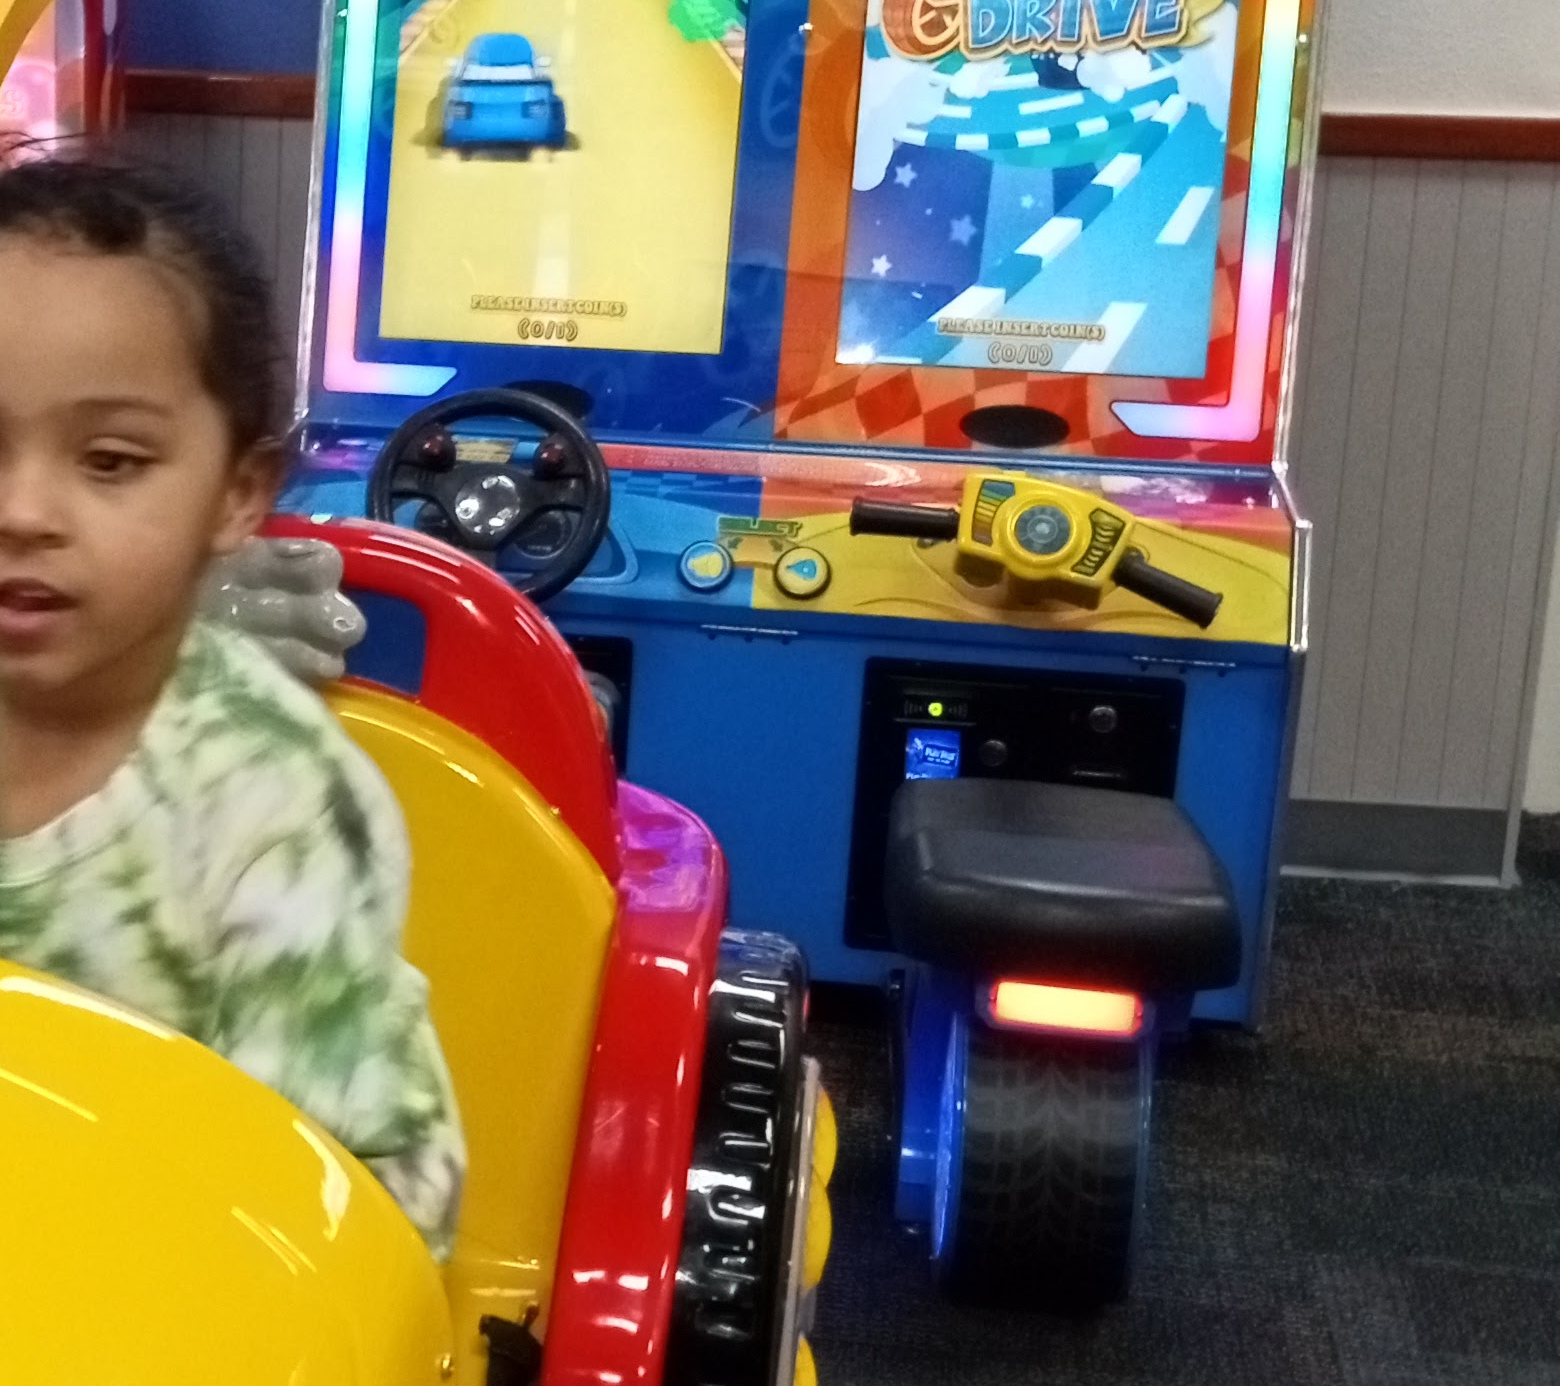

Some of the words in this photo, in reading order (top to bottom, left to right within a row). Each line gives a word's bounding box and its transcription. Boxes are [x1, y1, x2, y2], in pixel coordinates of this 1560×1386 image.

[471, 294, 522, 312] PLEASE
[938, 317, 993, 334] PLEASE
[993, 320, 1049, 337] INSERT
